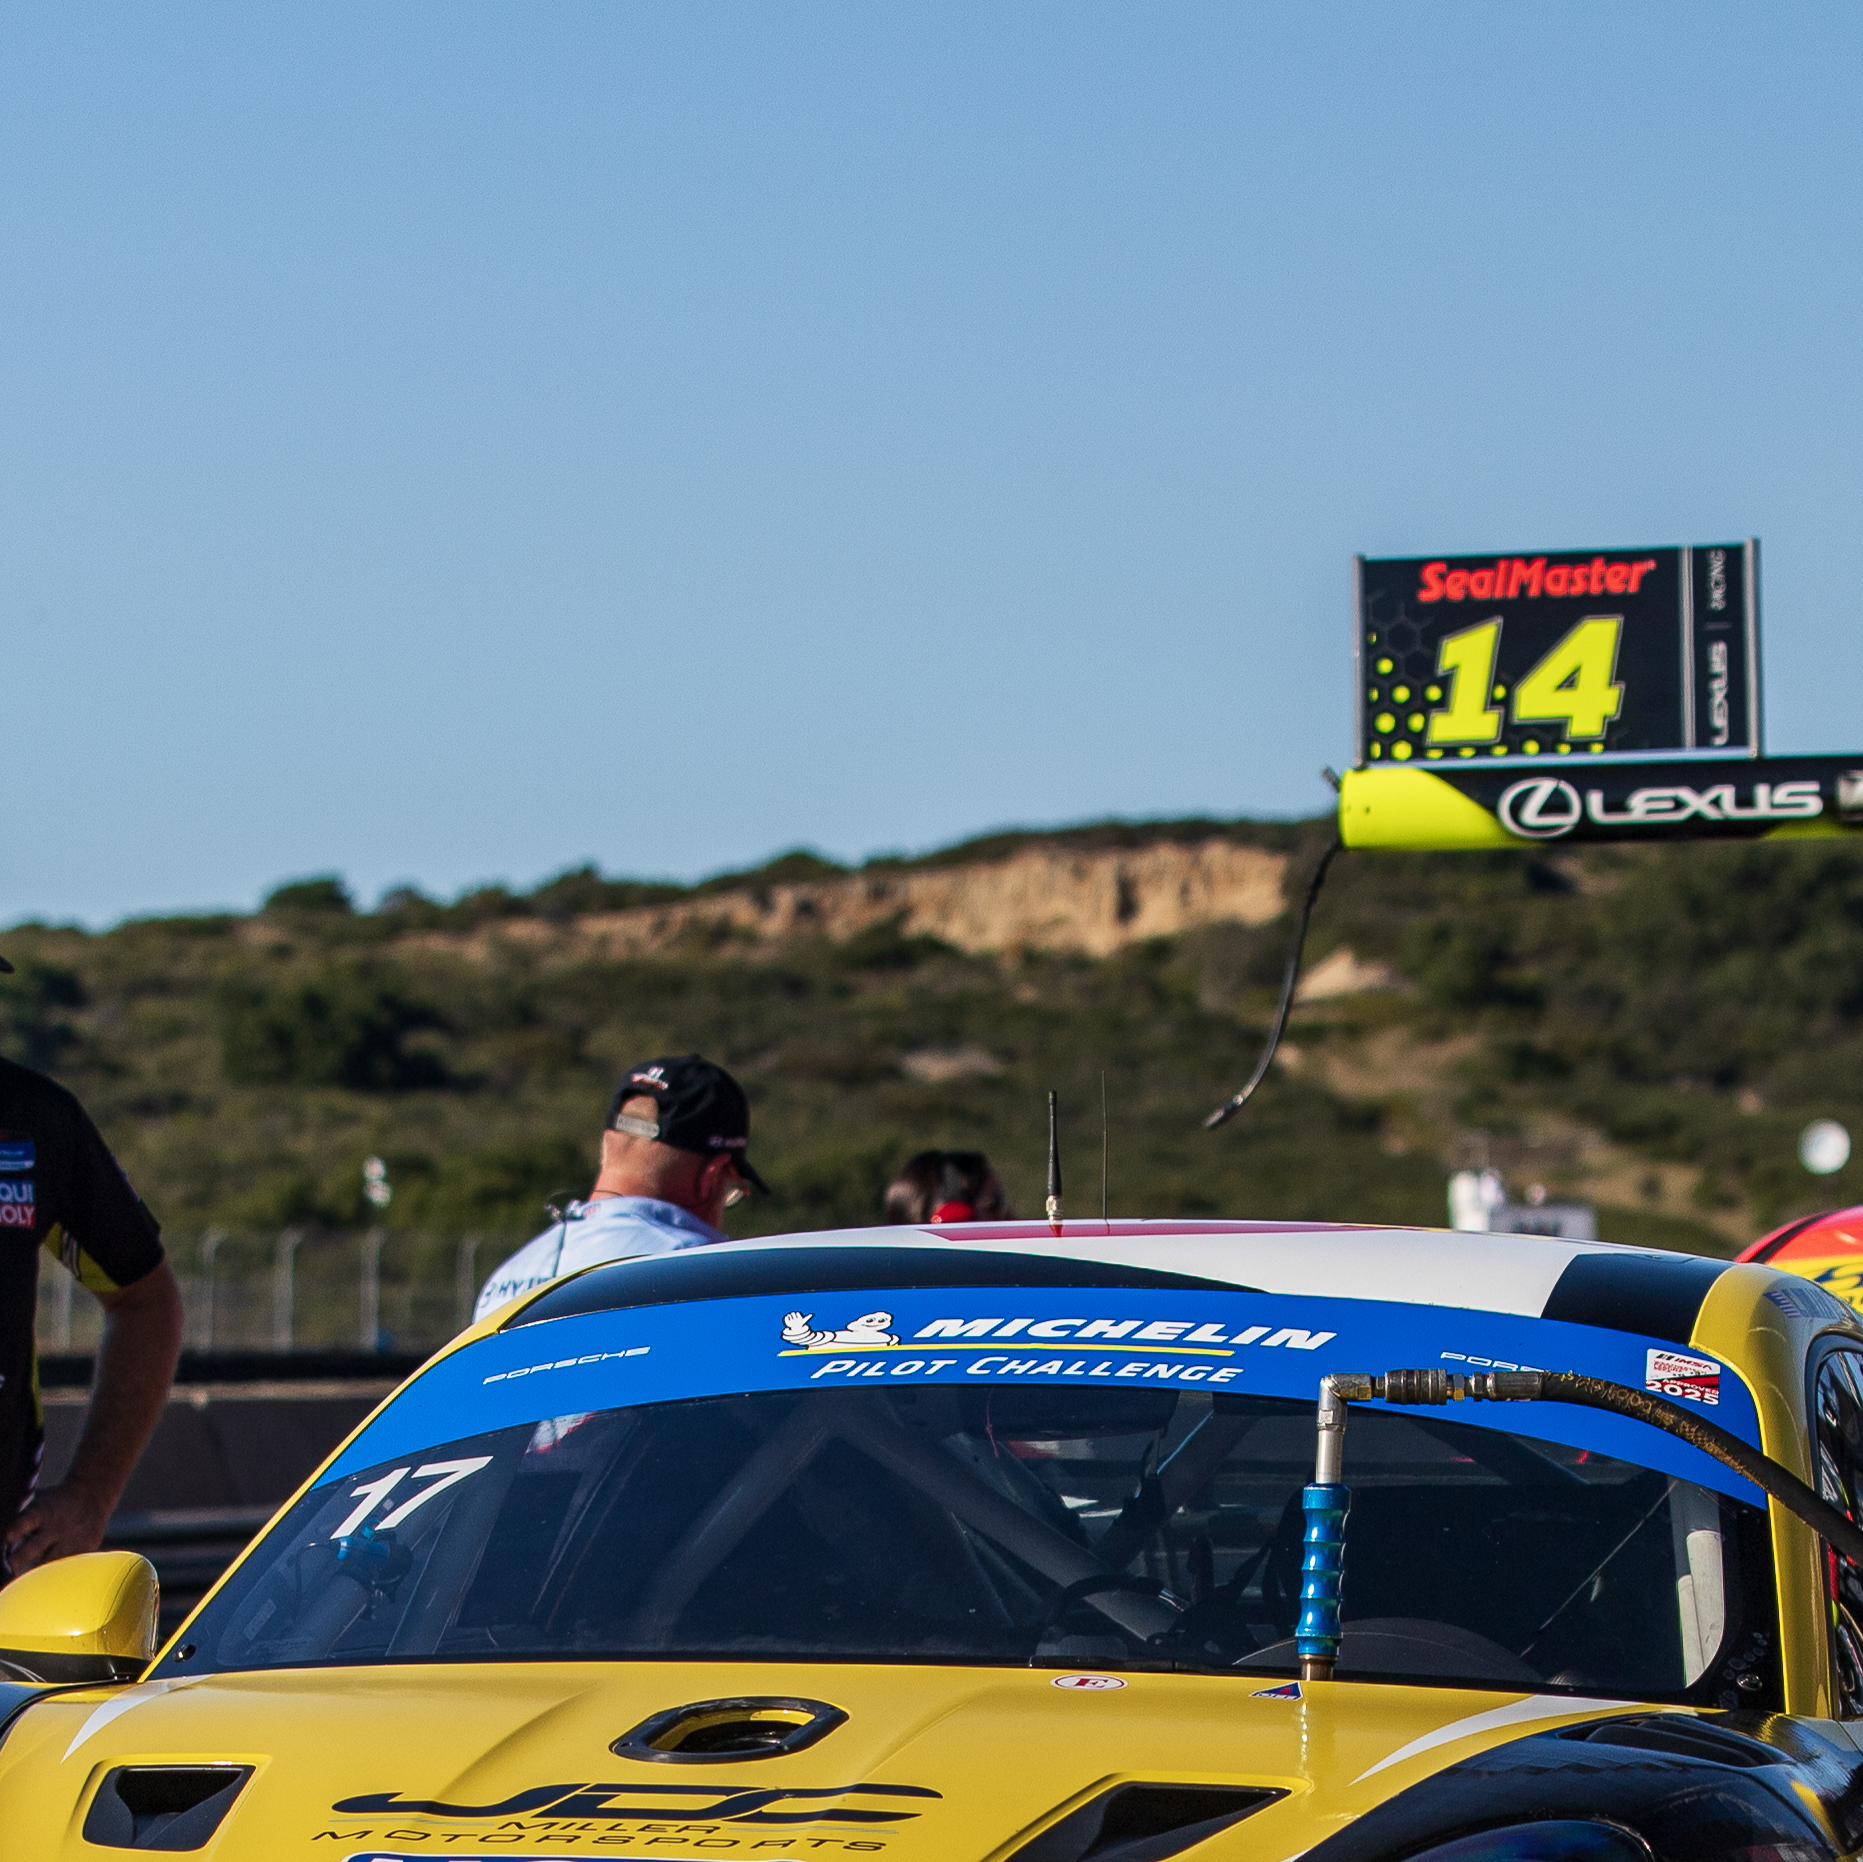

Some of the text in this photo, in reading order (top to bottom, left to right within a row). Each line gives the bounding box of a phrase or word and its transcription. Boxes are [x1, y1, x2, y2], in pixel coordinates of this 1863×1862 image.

[1418, 557, 1653, 602] SealMaster
[1425, 614, 1625, 746] 14
[1587, 780, 1823, 826] LEXUS
[912, 1318, 1337, 1351] MICHELIN
[482, 1346, 651, 1385] PORSCHE
[810, 1356, 1245, 1384] PILOT CHALLENGE
[1645, 1380, 1719, 1406] 2025
[330, 1455, 494, 1540] 17
[1074, 1678, 1109, 1688] E
[331, 1782, 943, 1824] JDC
[310, 1829, 888, 1852] MOTORSPORTS
[497, 1821, 727, 1835] MILLER
